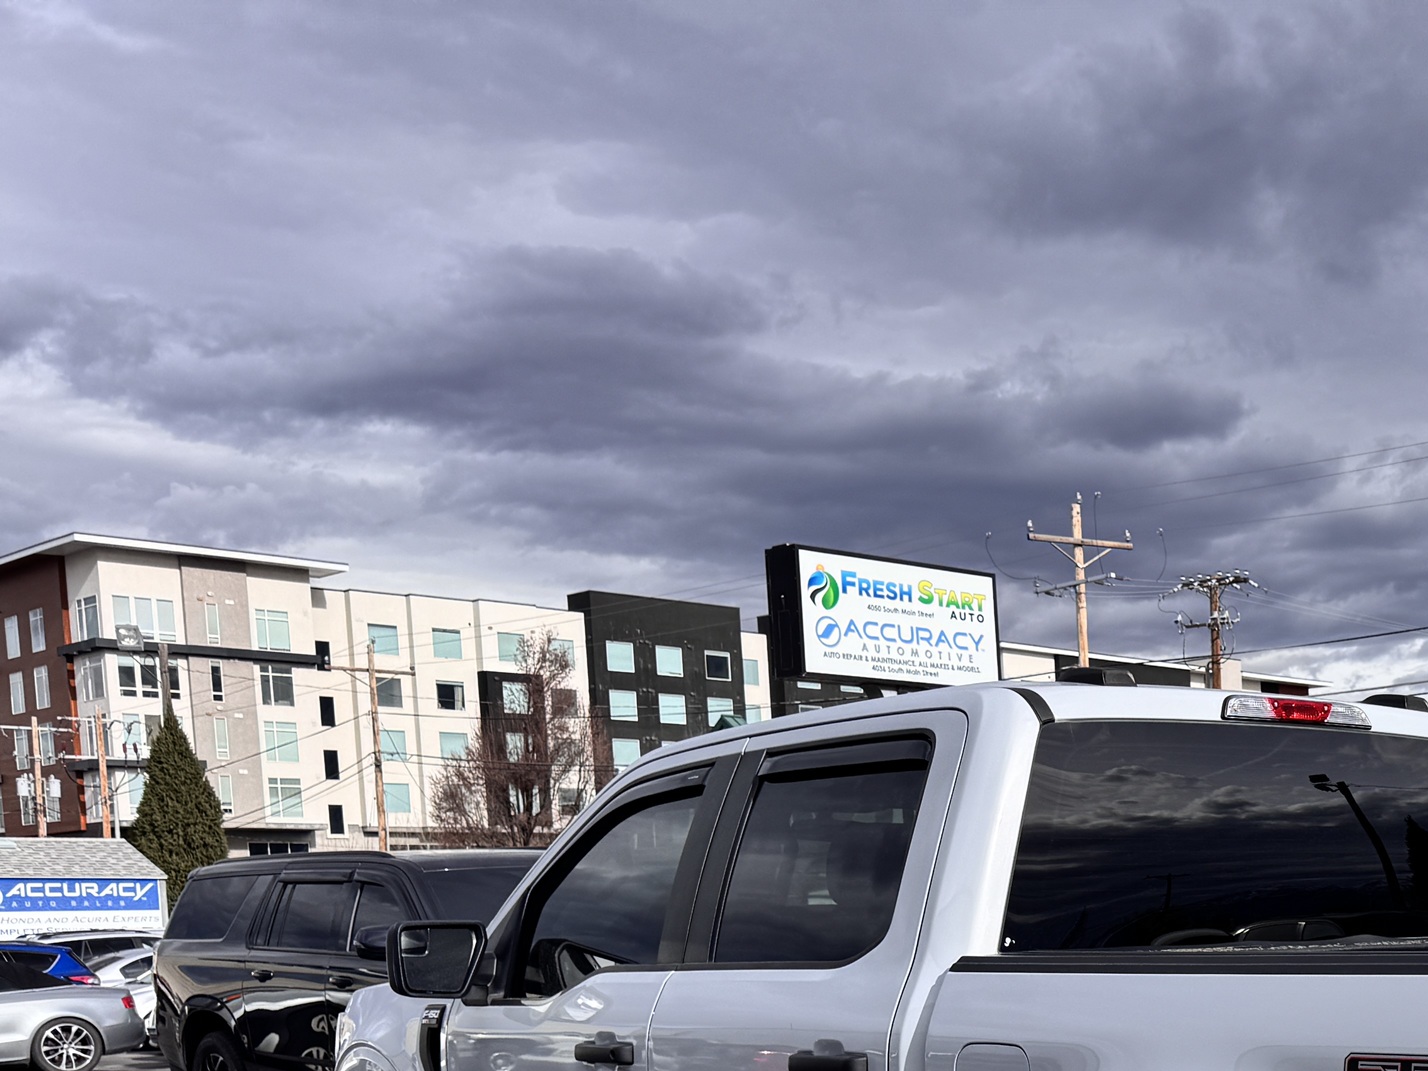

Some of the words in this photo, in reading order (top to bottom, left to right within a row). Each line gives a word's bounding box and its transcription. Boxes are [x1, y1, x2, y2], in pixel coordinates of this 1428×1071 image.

[841, 570, 912, 603] FRESH
[918, 579, 986, 612] START
[883, 605, 899, 614] South
[901, 608, 916, 616] Main
[917, 610, 934, 618] Street
[950, 611, 984, 623] AUTO
[844, 619, 984, 652] ACCURACY
[823, 651, 840, 659] AUTO
[842, 653, 863, 661] REPAIR
[930, 662, 949, 670] MAKES
[862, 643, 974, 663] AUTOMOTIVE
[887, 666, 904, 674] South
[906, 668, 921, 676] Main
[5, 882, 154, 901] ACCURACY
